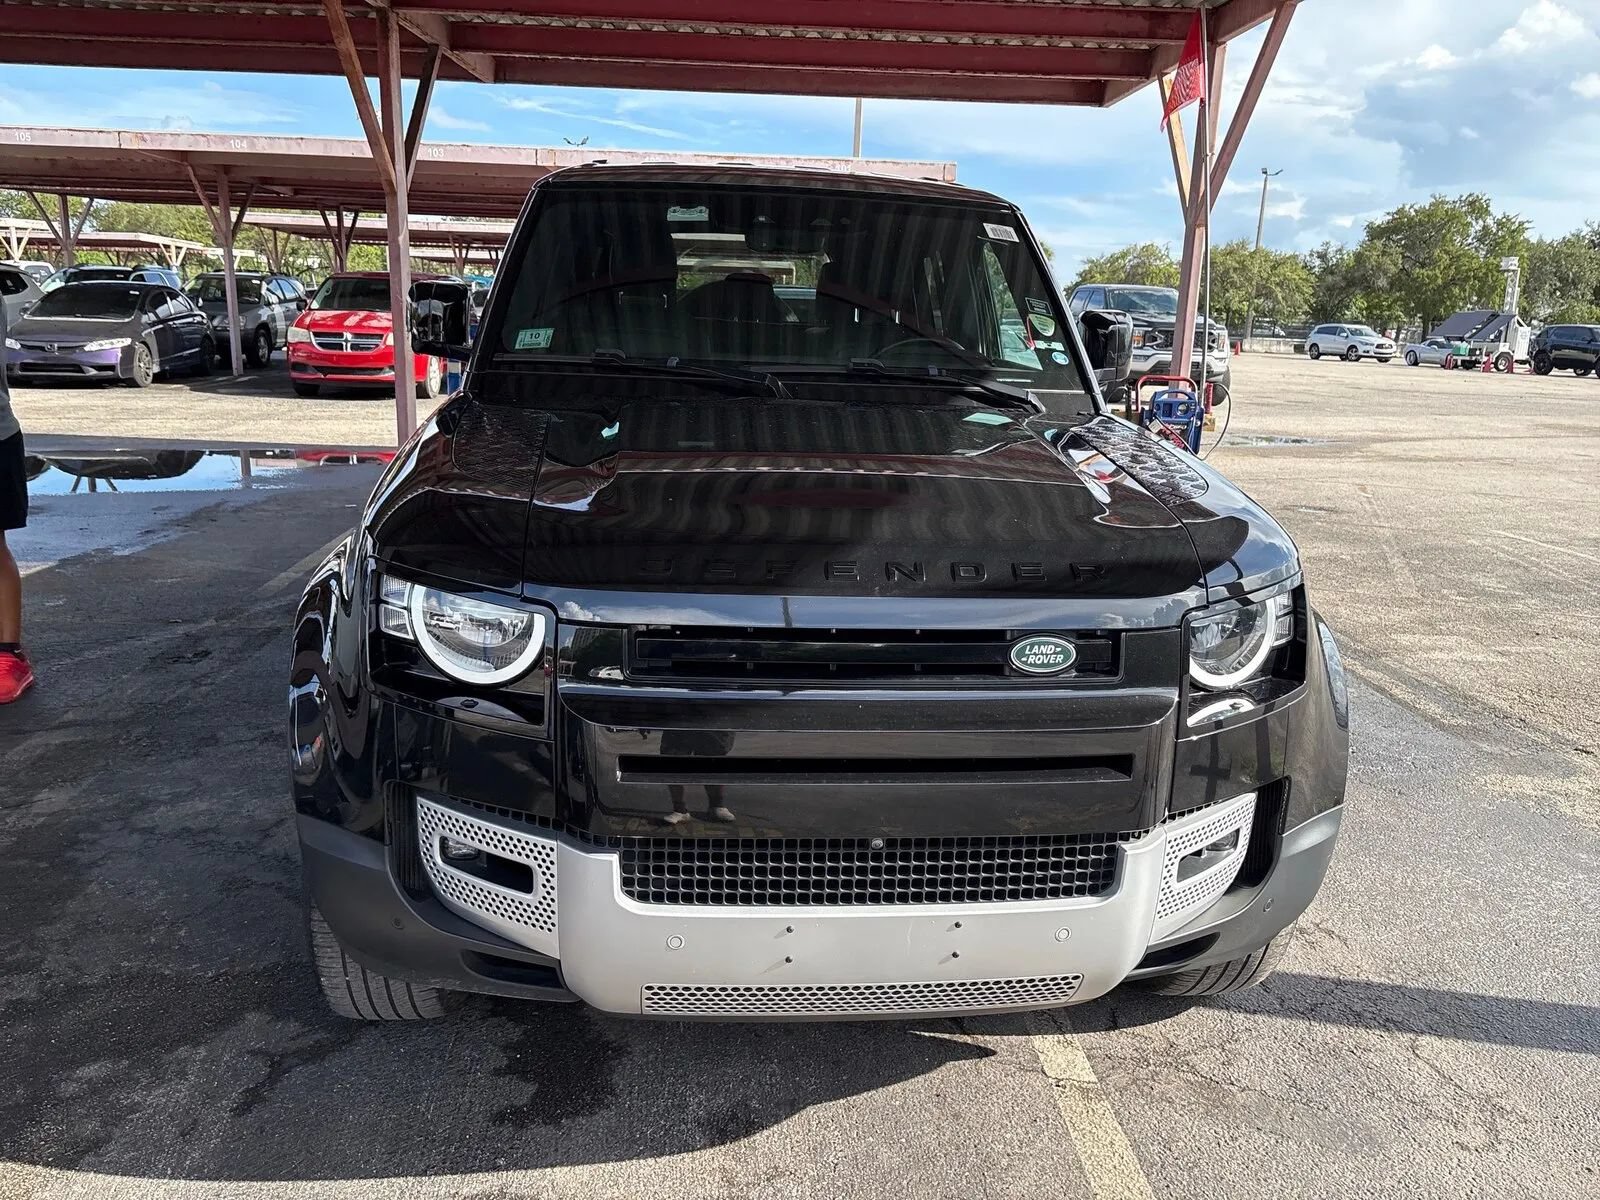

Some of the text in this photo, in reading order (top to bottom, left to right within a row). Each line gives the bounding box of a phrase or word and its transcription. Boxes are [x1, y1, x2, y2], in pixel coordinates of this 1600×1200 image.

[15, 131, 32, 142] 105
[230, 139, 247, 149] 104
[427, 147, 445, 158] 103
[529, 332, 541, 340] 10
[636, 558, 1106, 583] DEFENDER
[1025, 645, 1056, 655] LAND
[1027, 654, 1064, 665] ROVER
